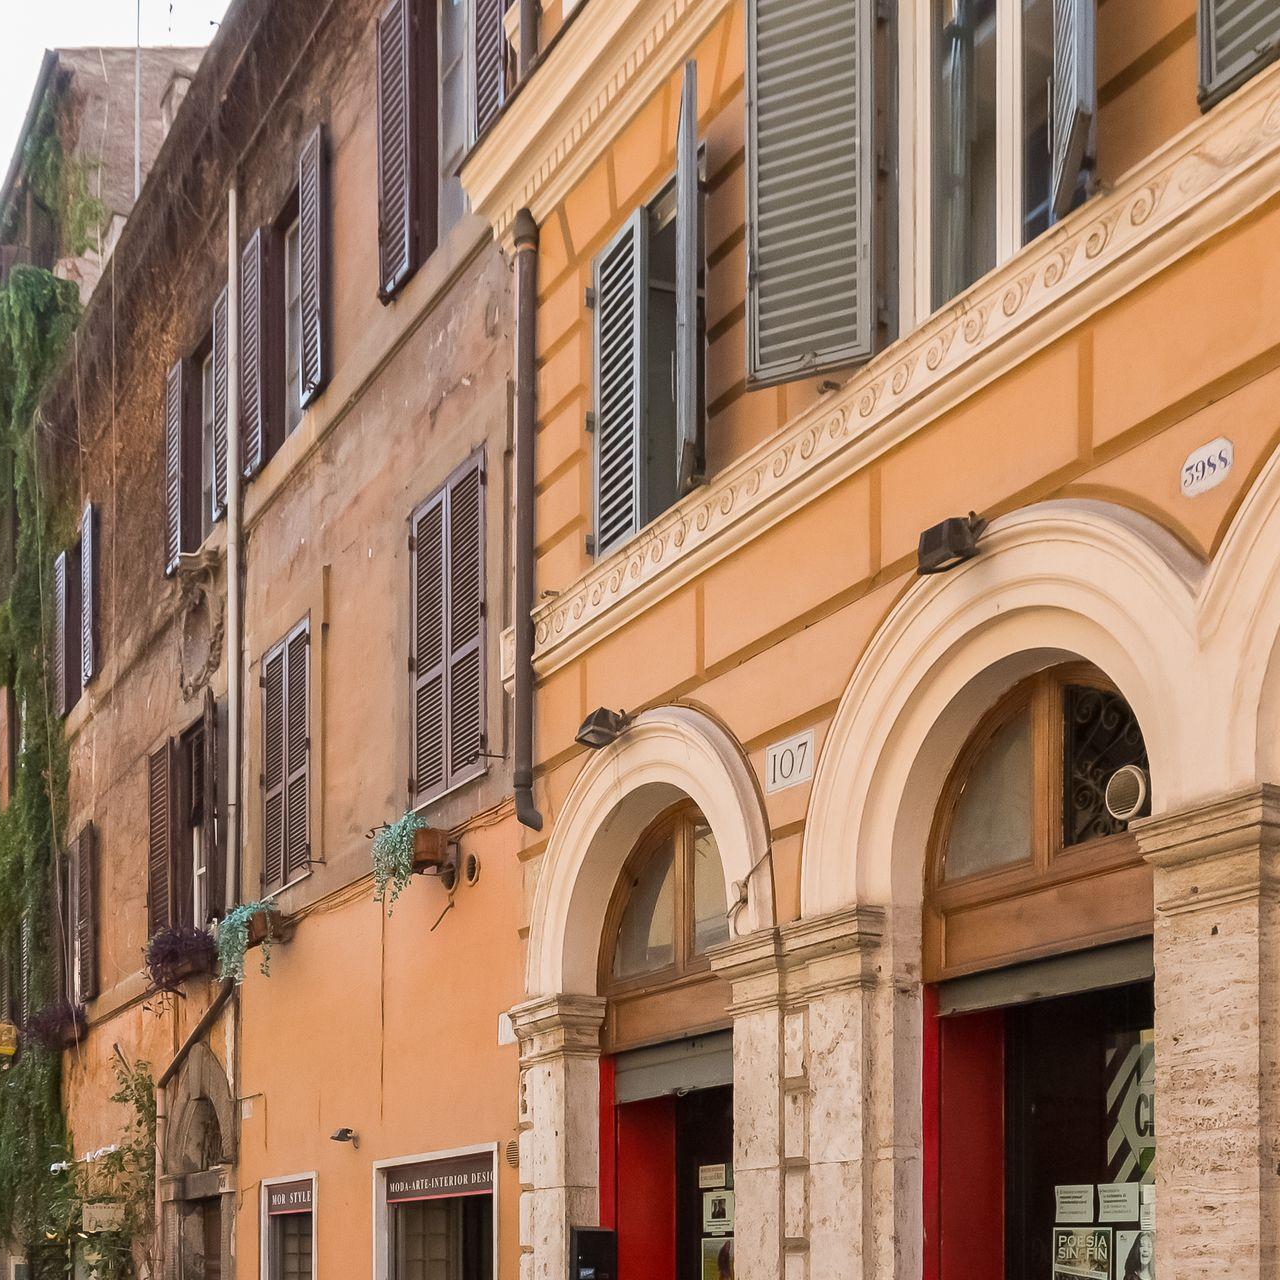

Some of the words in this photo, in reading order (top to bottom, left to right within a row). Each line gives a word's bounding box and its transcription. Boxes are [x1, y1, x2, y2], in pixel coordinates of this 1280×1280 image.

[771, 741, 808, 784] 107
[389, 1173, 469, 1193] MODA-ARTE-INTERIOR
[272, 1194, 286, 1205] MOR
[290, 1190, 312, 1204] STYLE
[1058, 1232, 1107, 1248] POESÍA
[1057, 1247, 1079, 1260] SIN
[1086, 1247, 1108, 1260] FIN
